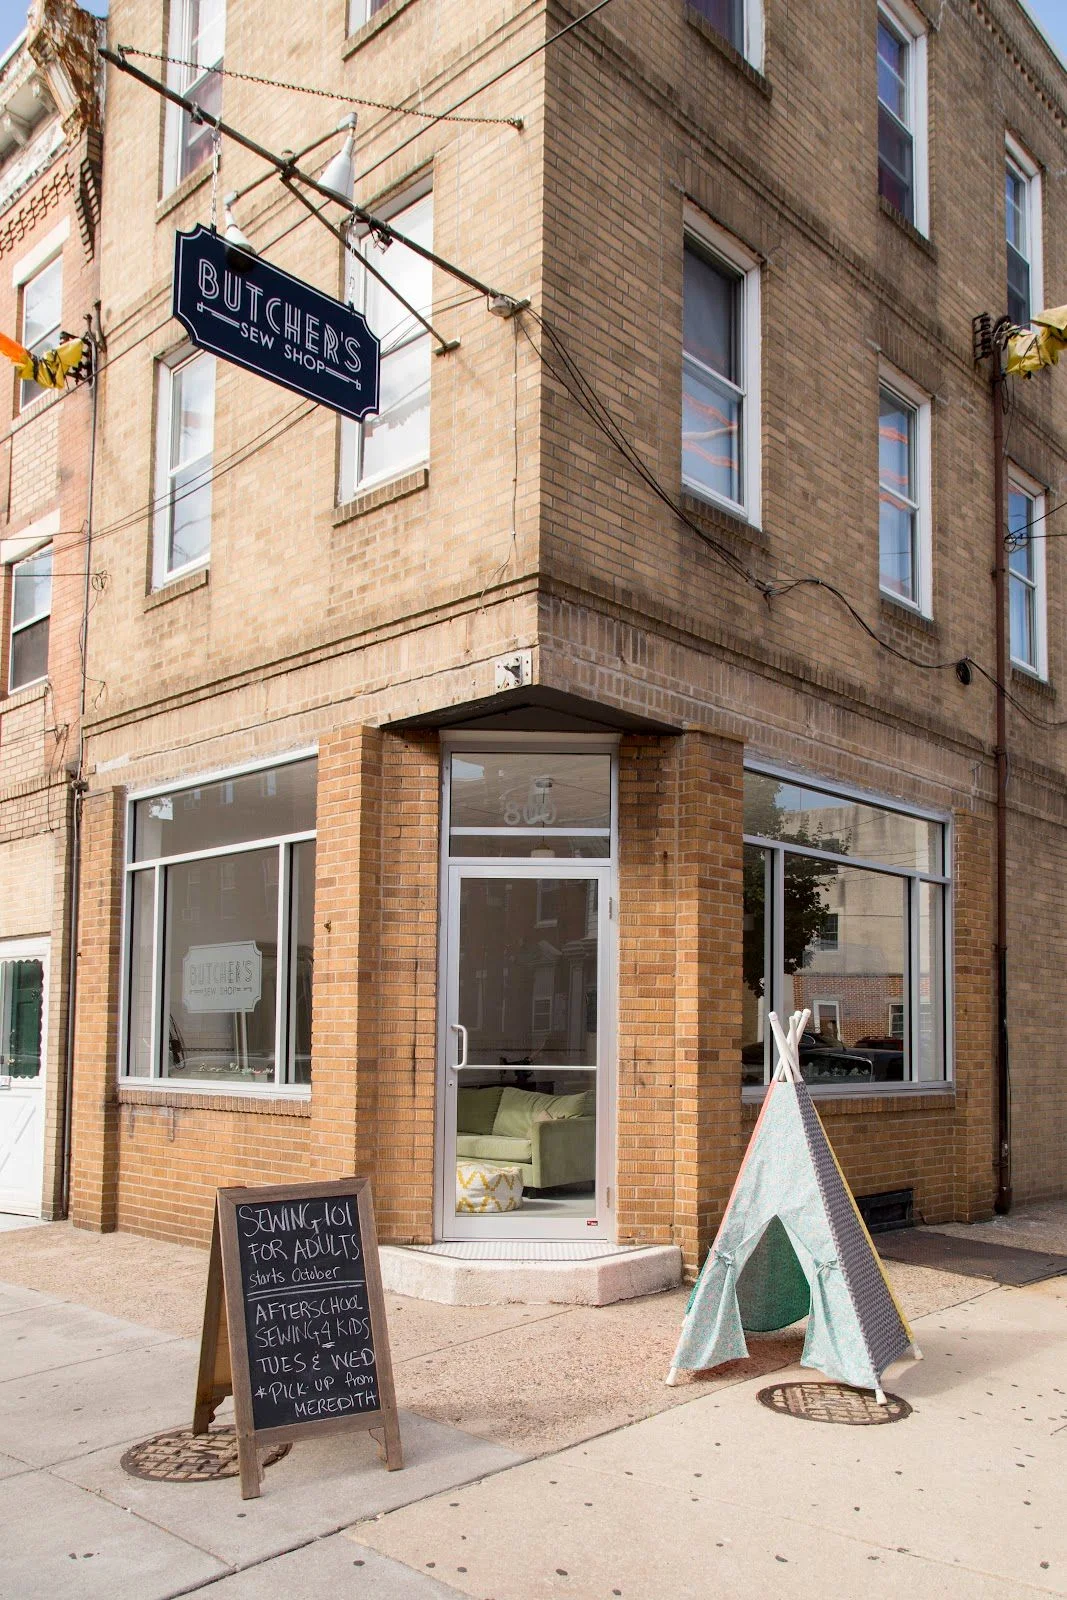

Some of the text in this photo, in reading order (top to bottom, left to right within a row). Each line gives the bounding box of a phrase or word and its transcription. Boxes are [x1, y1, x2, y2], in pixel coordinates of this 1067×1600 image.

[198, 258, 362, 373] BUTCHER'S
[240, 322, 325, 374] SEW SHOP
[189, 960, 253, 985] BUTCHER'S
[238, 1202, 353, 1237] SEWING 101
[248, 1233, 360, 1264] FOR ADULTS
[291, 1265, 341, 1283] October
[255, 1294, 364, 1326] AFTERSCHOOL
[254, 1320, 322, 1348] SEWING
[336, 1317, 370, 1340] KIDS
[255, 1352, 307, 1375] TUES
[331, 1348, 375, 1371] WED
[344, 1372, 374, 1387] from
[294, 1390, 377, 1418] MEREDITH
